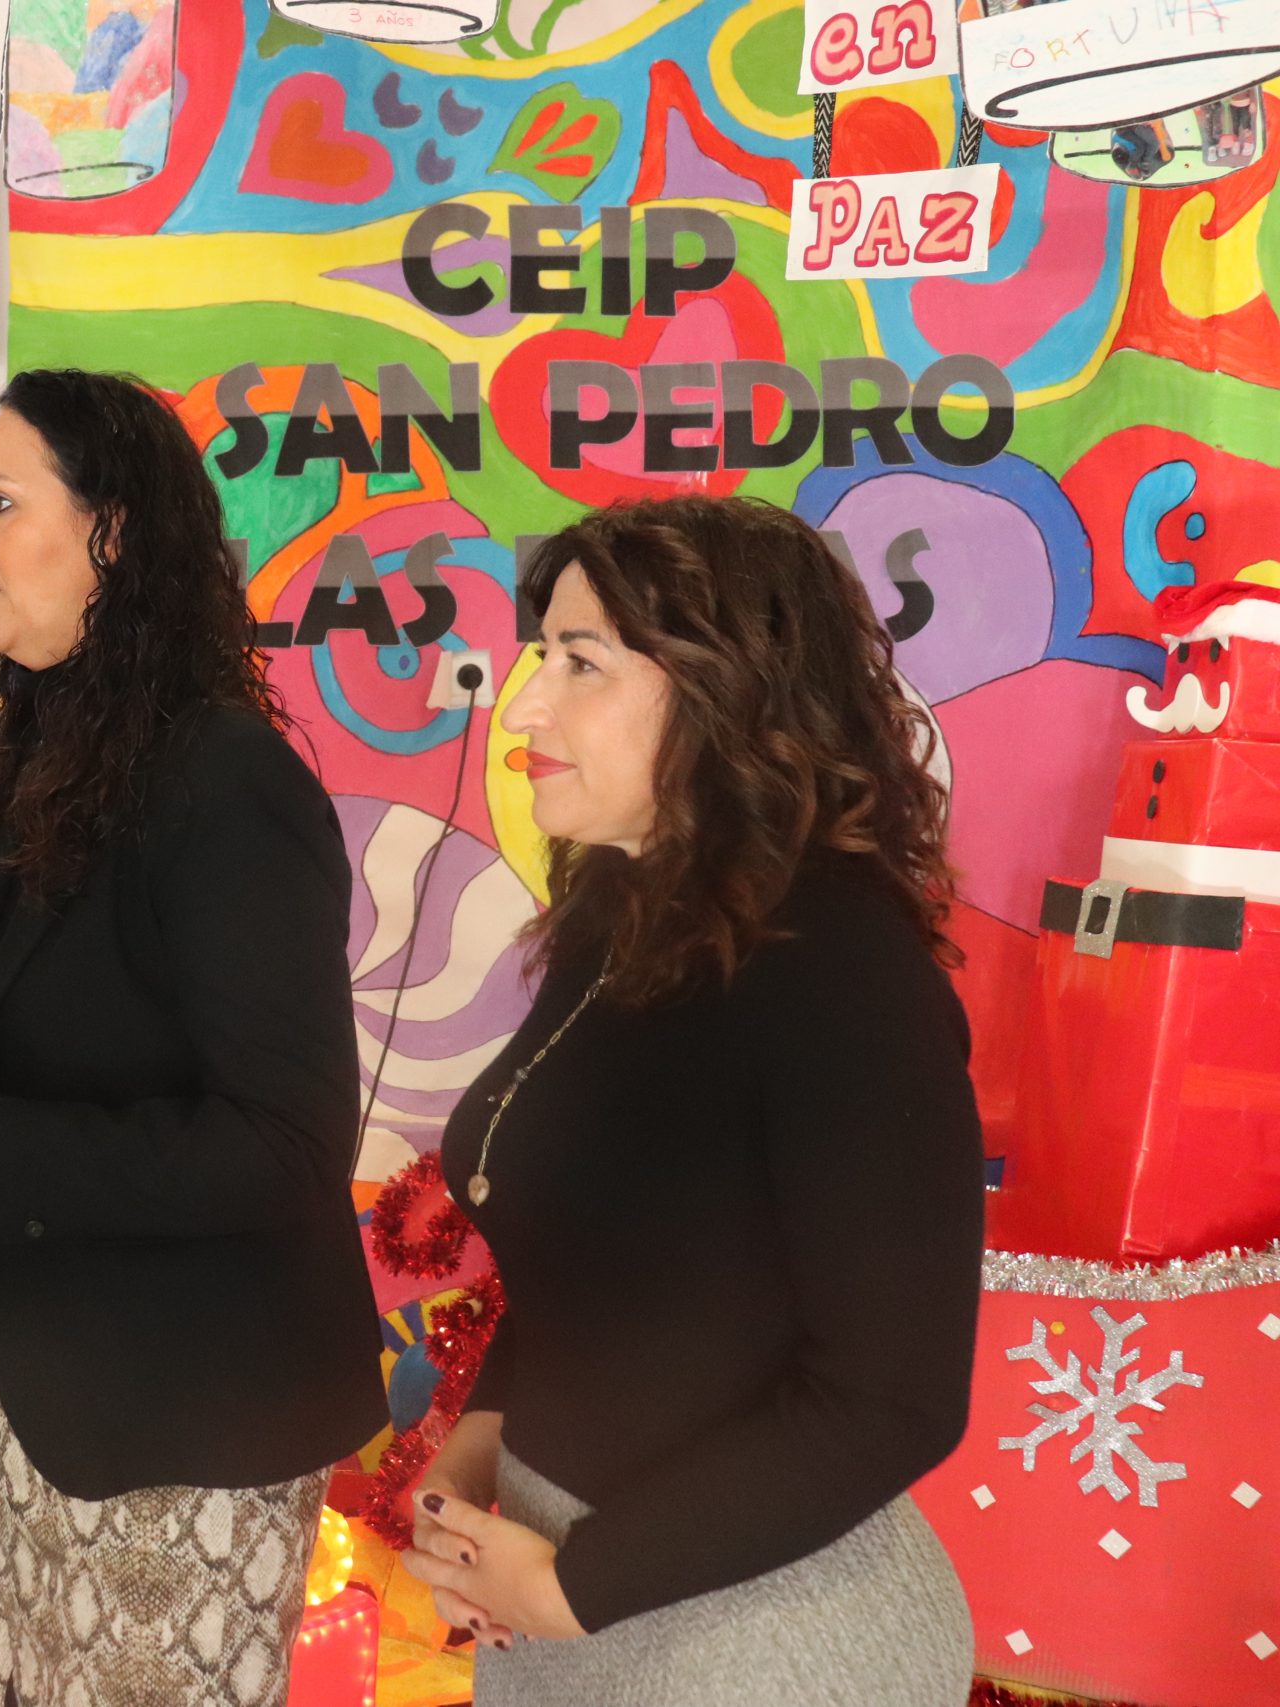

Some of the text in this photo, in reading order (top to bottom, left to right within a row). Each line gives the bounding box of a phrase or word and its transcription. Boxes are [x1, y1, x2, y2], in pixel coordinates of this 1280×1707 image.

[348, 8, 415, 28] 3 AÑOS
[810, 0, 937, 85] en
[993, 0, 1230, 72] FORTUNA
[402, 203, 737, 318] CEIP
[803, 178, 979, 270] PAZ
[213, 353, 1016, 480] SAN PEDRO
[223, 531, 458, 648] LAS
